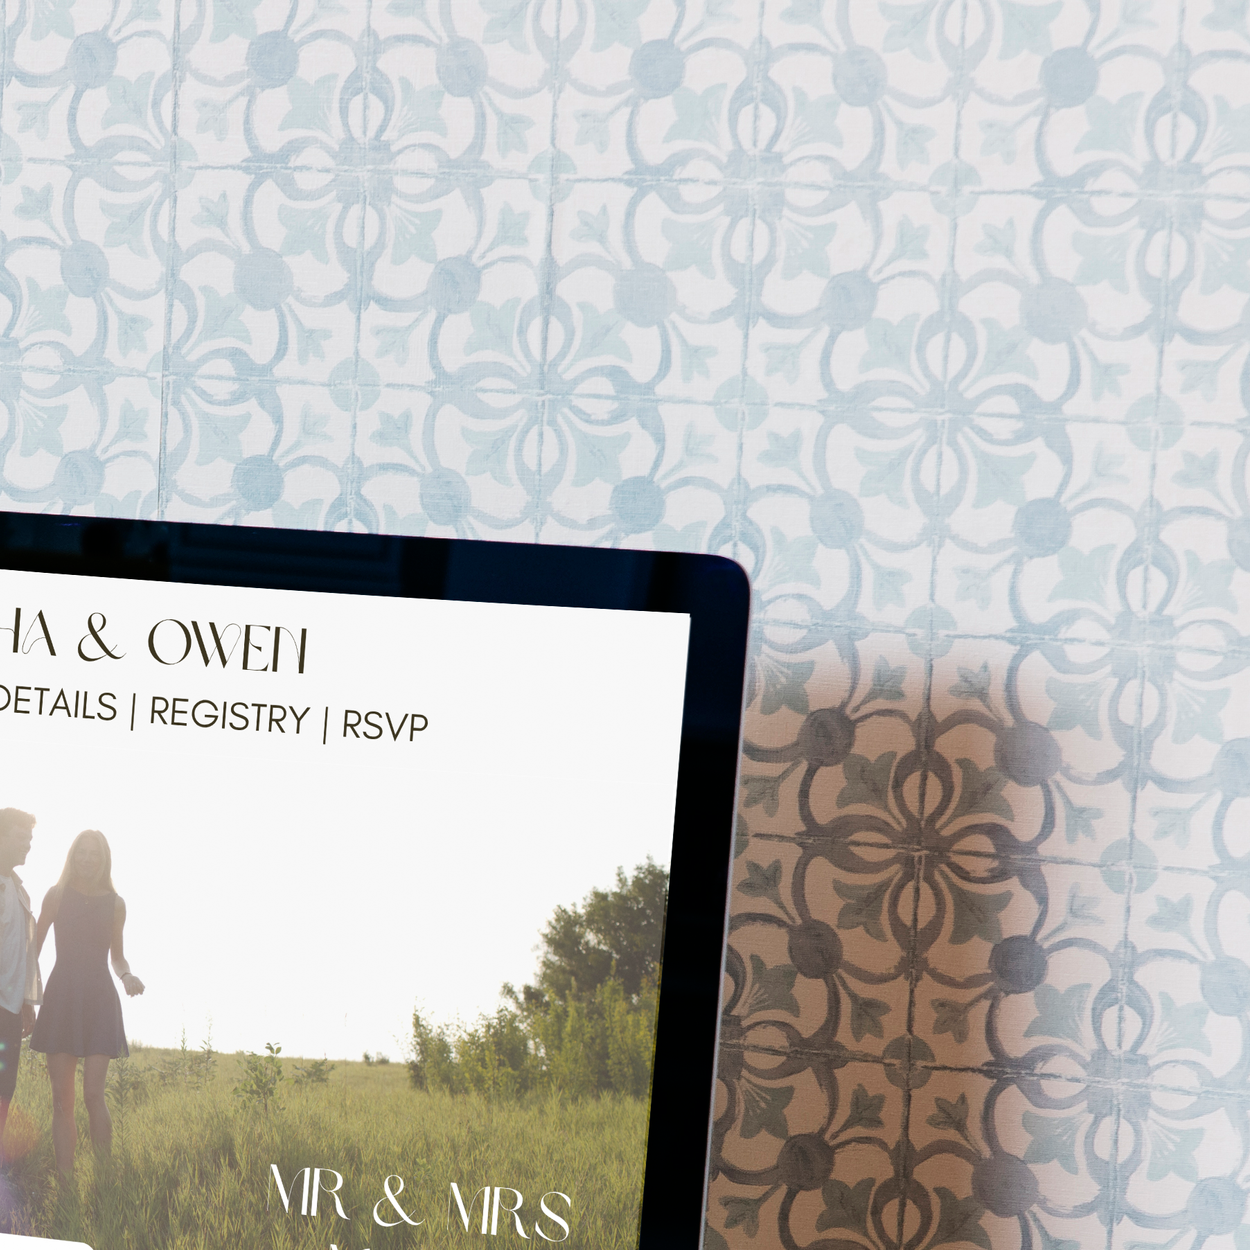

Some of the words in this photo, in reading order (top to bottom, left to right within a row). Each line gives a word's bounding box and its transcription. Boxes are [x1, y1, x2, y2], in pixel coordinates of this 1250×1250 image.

[76, 612, 126, 662] &
[147, 618, 308, 674] OWEN
[150, 696, 311, 735] REGISTRY
[342, 709, 429, 742] RSVP
[266, 1163, 350, 1221] MR
[372, 1174, 425, 1228] &
[446, 1181, 572, 1243] MRS
